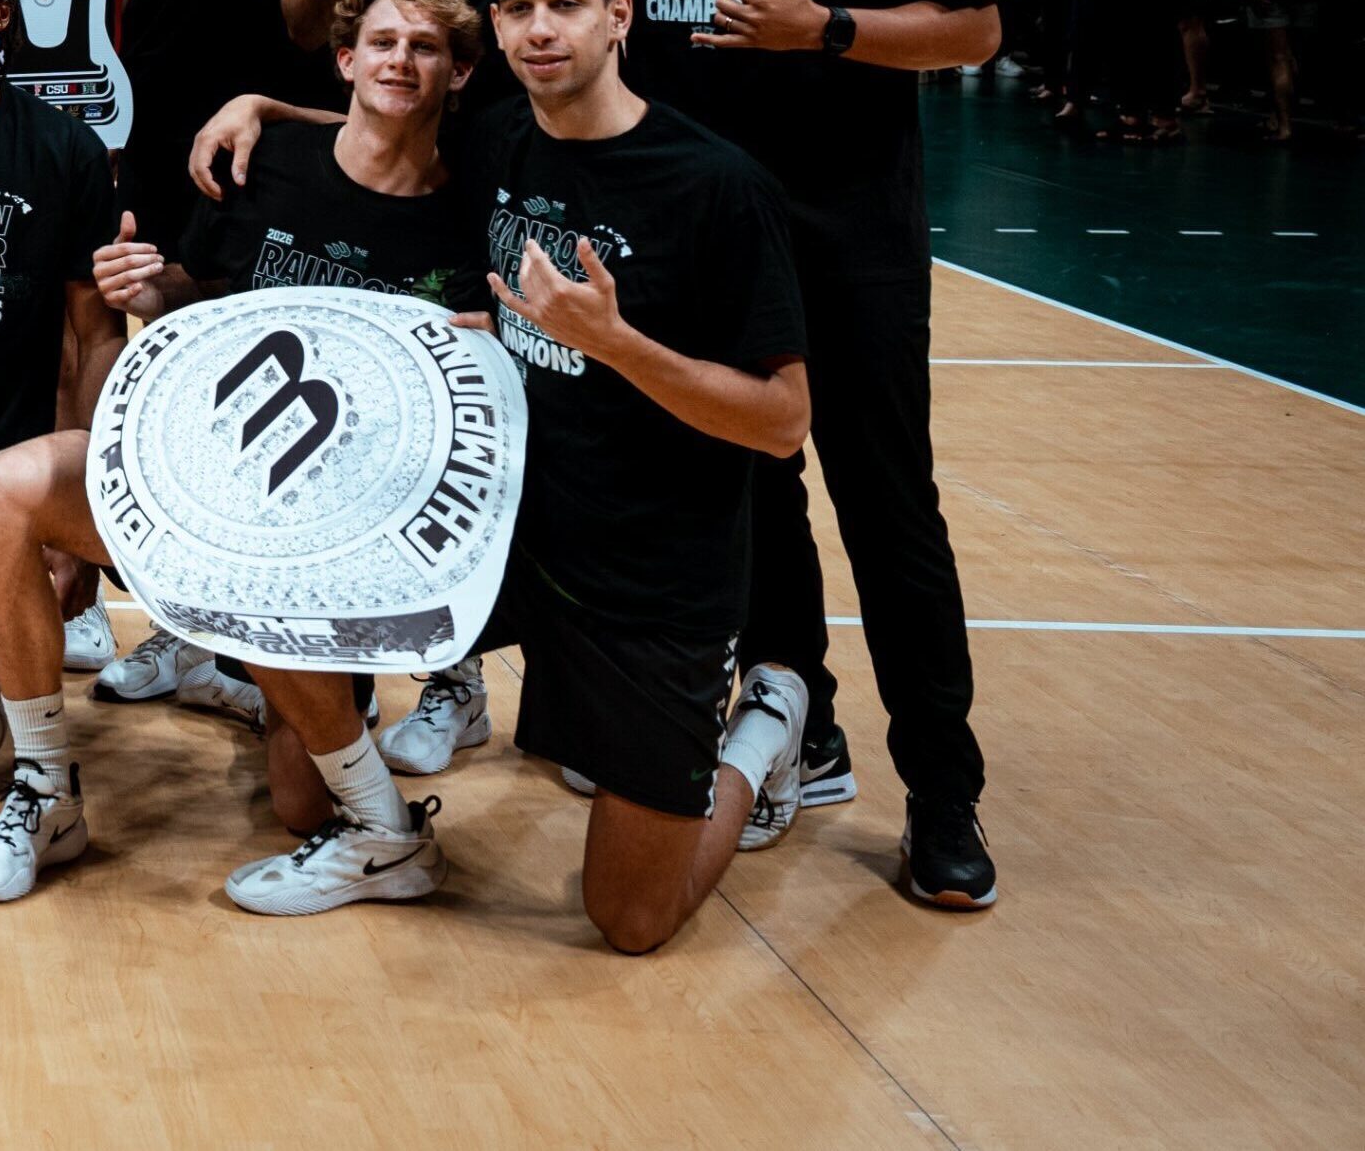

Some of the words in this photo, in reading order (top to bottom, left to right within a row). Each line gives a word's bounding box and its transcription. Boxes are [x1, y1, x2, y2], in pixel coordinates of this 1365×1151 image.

[552, 201, 566, 210] THE
[267, 228, 294, 246] 2026
[353, 246, 369, 257] THE
[499, 318, 587, 377] MPIONS
[397, 320, 499, 569] CHAMPIONS
